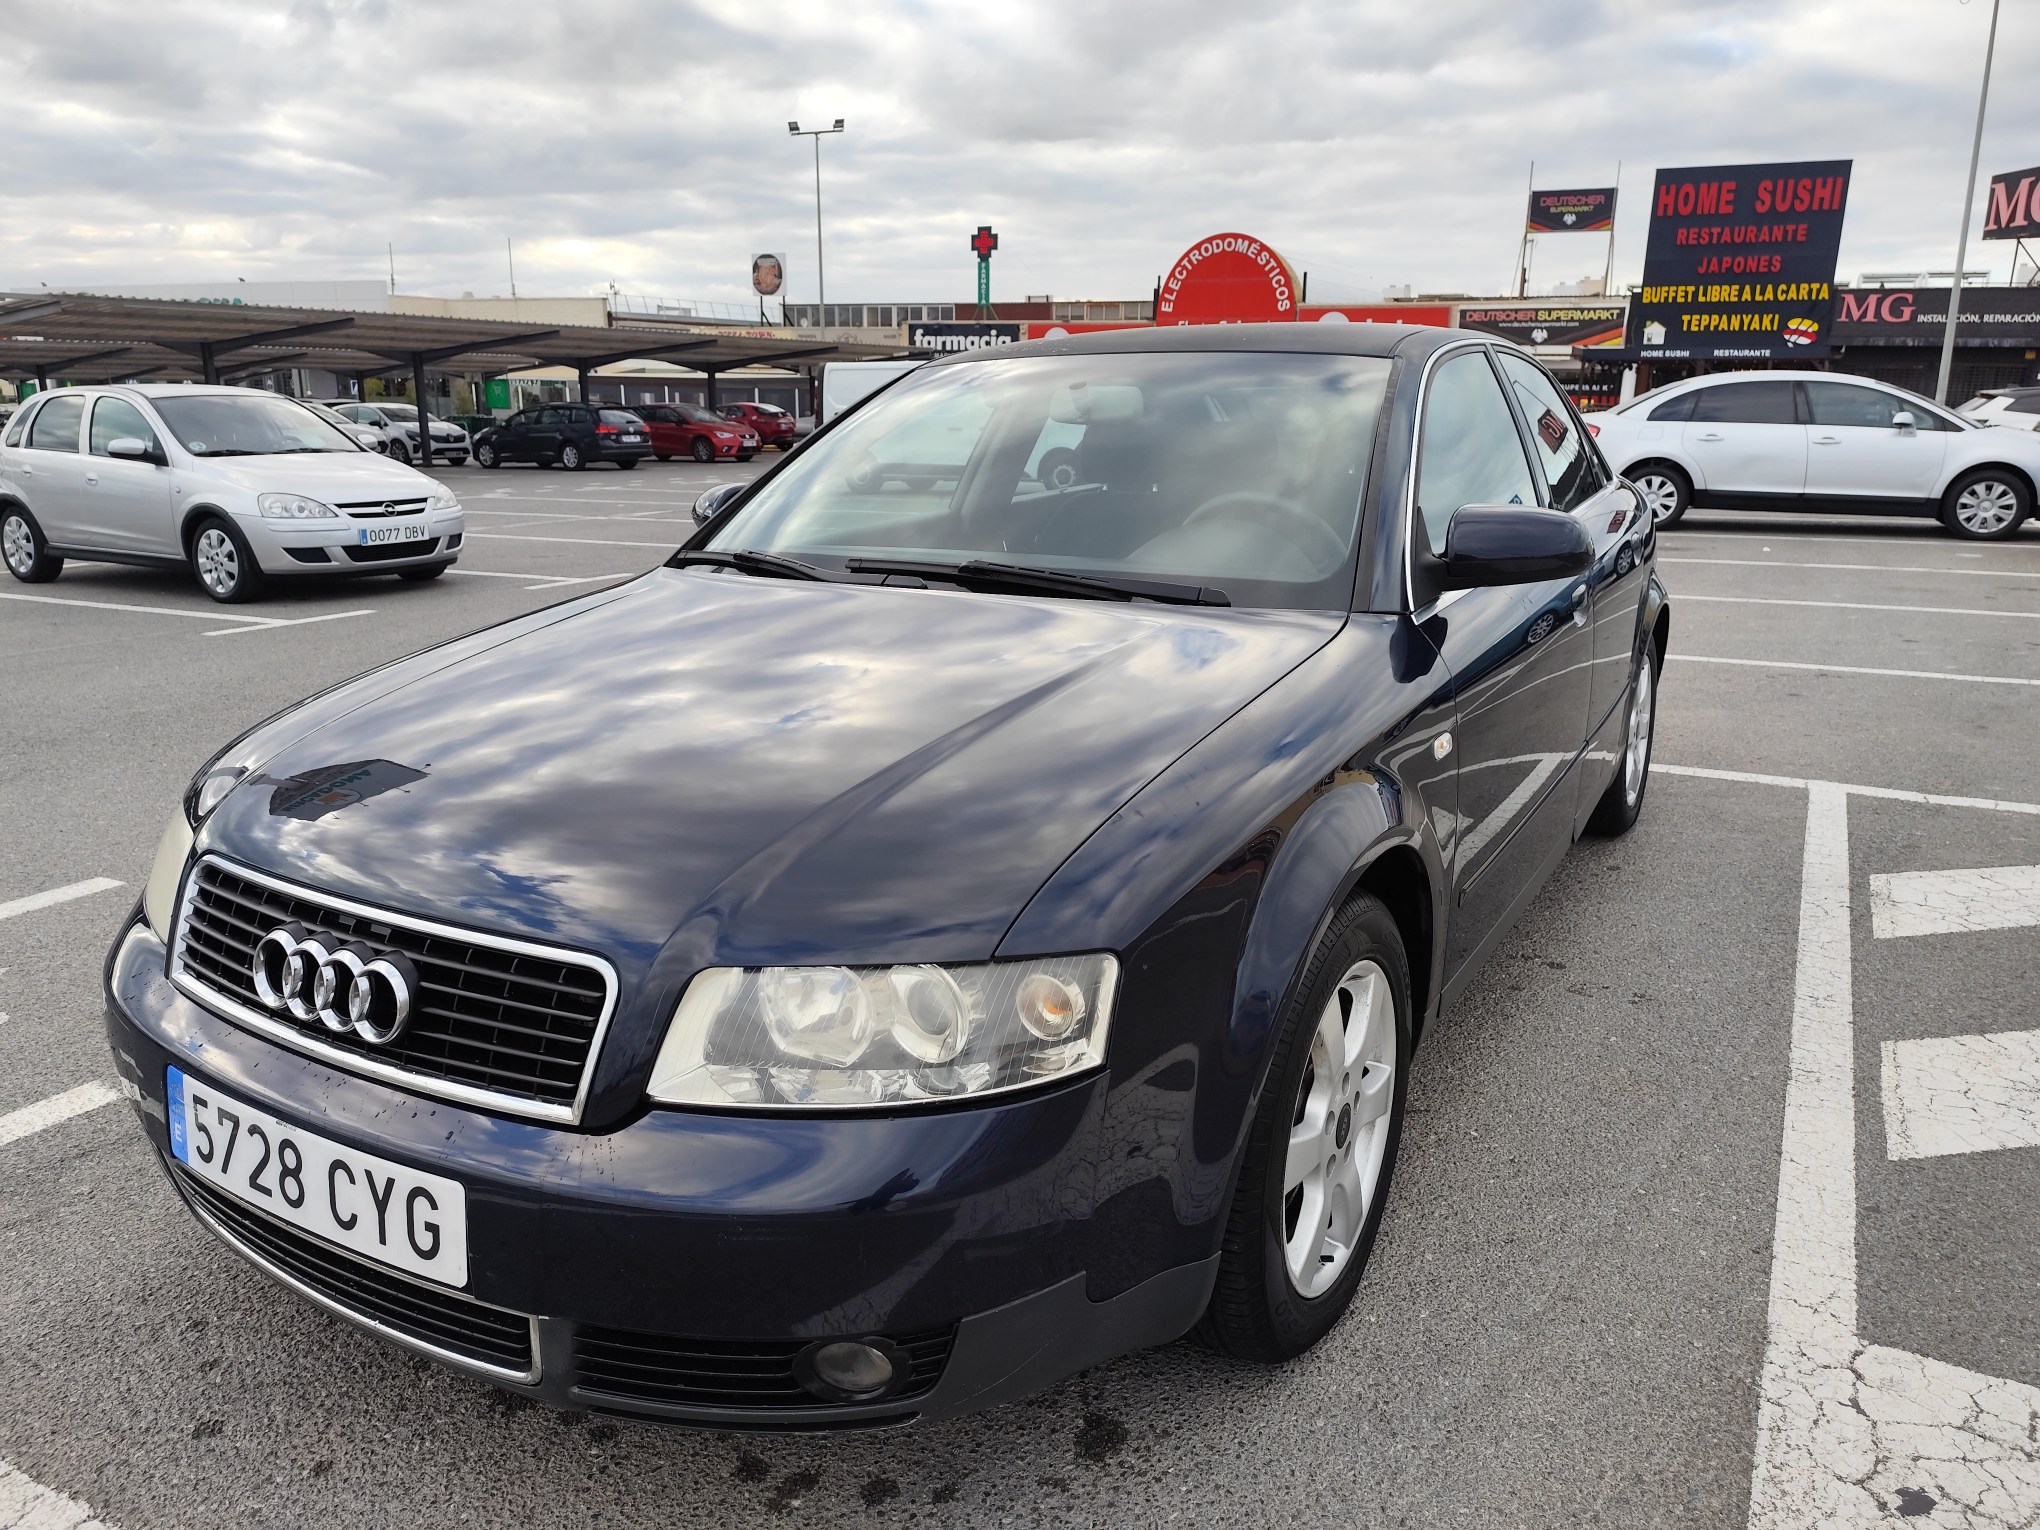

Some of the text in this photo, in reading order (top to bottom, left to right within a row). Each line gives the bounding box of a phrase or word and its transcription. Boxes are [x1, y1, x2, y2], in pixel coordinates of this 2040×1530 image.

[1540, 195, 1605, 207] DEUTSCHER
[1656, 177, 1844, 217] HOME SUSHI
[1984, 176, 2040, 231] M
[1550, 205, 1594, 213] SUPERMARKT
[1676, 224, 1808, 245] RESTAURANTE
[1697, 255, 1782, 274] JAPONES
[1161, 238, 1290, 313] ELECTRODOMÉSTICOS
[1642, 283, 1829, 303] BUFFET LIBRE A LA CARTA
[1466, 310, 1620, 321] DEUTSCHER SUPERMARKT
[1837, 293, 1916, 323] MG
[1682, 314, 1780, 331] TEPPANYAKI
[1917, 312, 1980, 324] INSTALCIÓN,
[914, 328, 1011, 350] farmacia
[1713, 349, 1771, 357] RESTAURANTE
[369, 525, 425, 542] 0077 DBV
[192, 1093, 441, 1261] 5728 CYG
